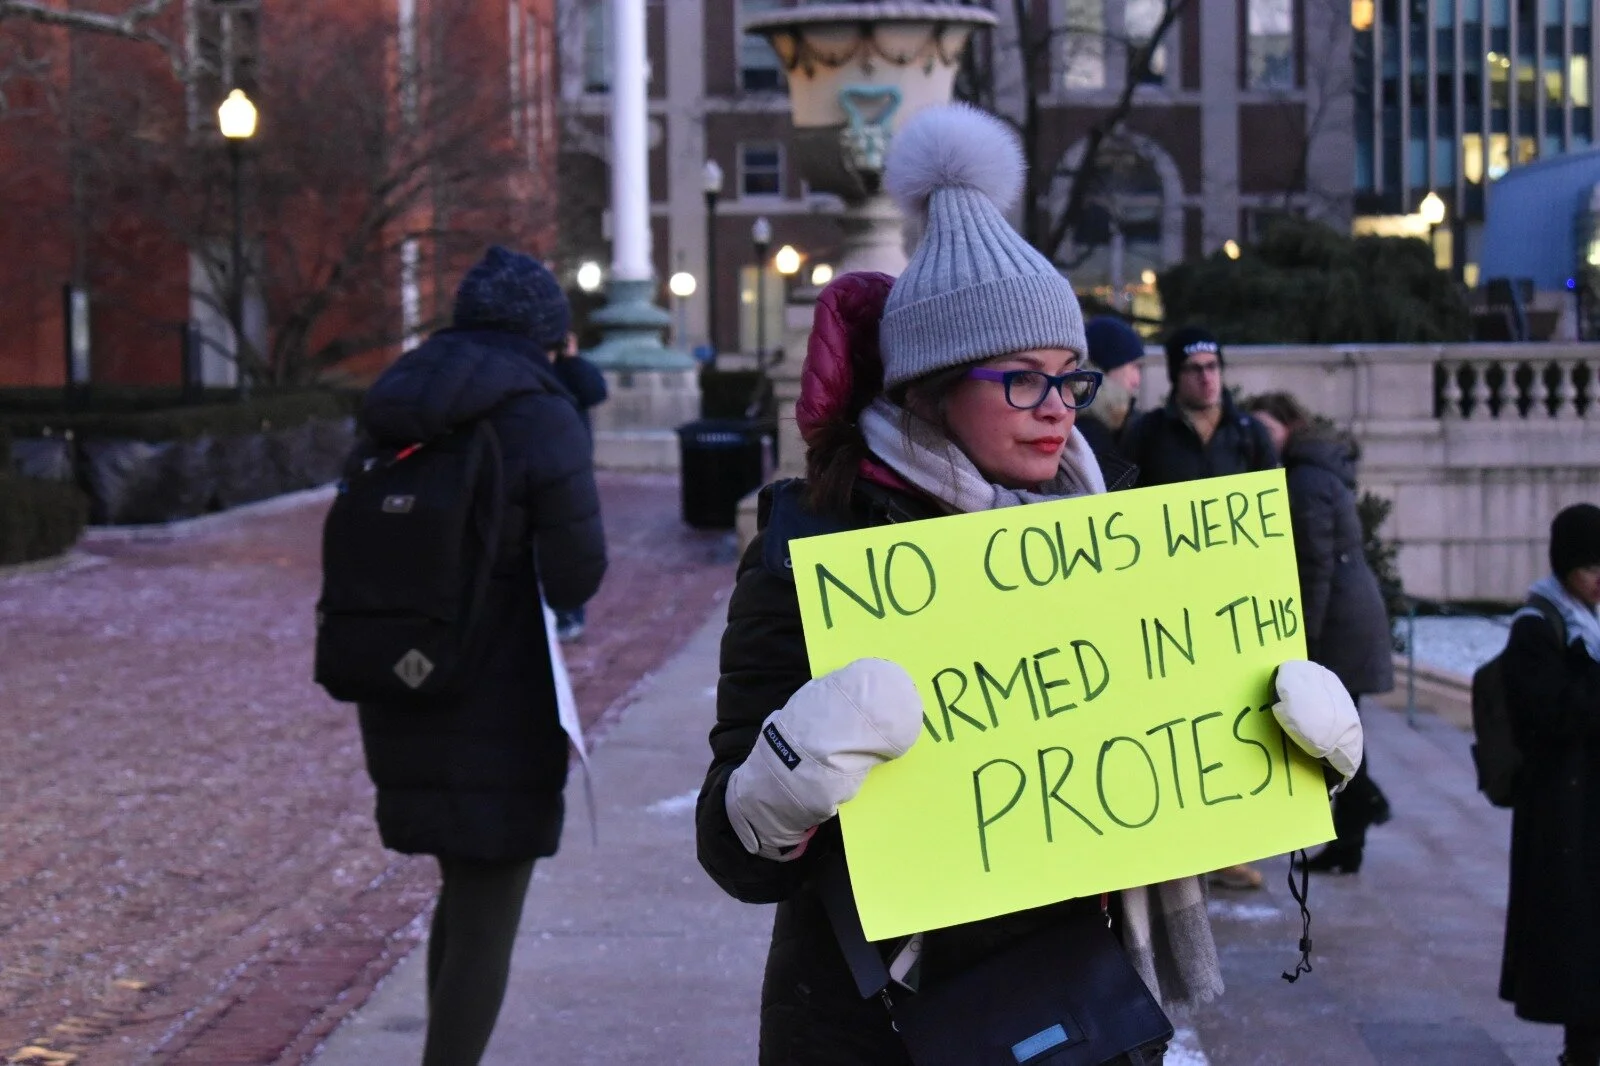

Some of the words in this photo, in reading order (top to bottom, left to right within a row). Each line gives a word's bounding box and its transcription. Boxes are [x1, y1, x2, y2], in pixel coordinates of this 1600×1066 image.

[814, 541, 937, 630] NO
[983, 511, 1141, 592] COWS
[1162, 488, 1285, 558] WERE
[922, 639, 1110, 743] RMED
[1140, 607, 1196, 680] IN
[1215, 595, 1298, 654] THIS
